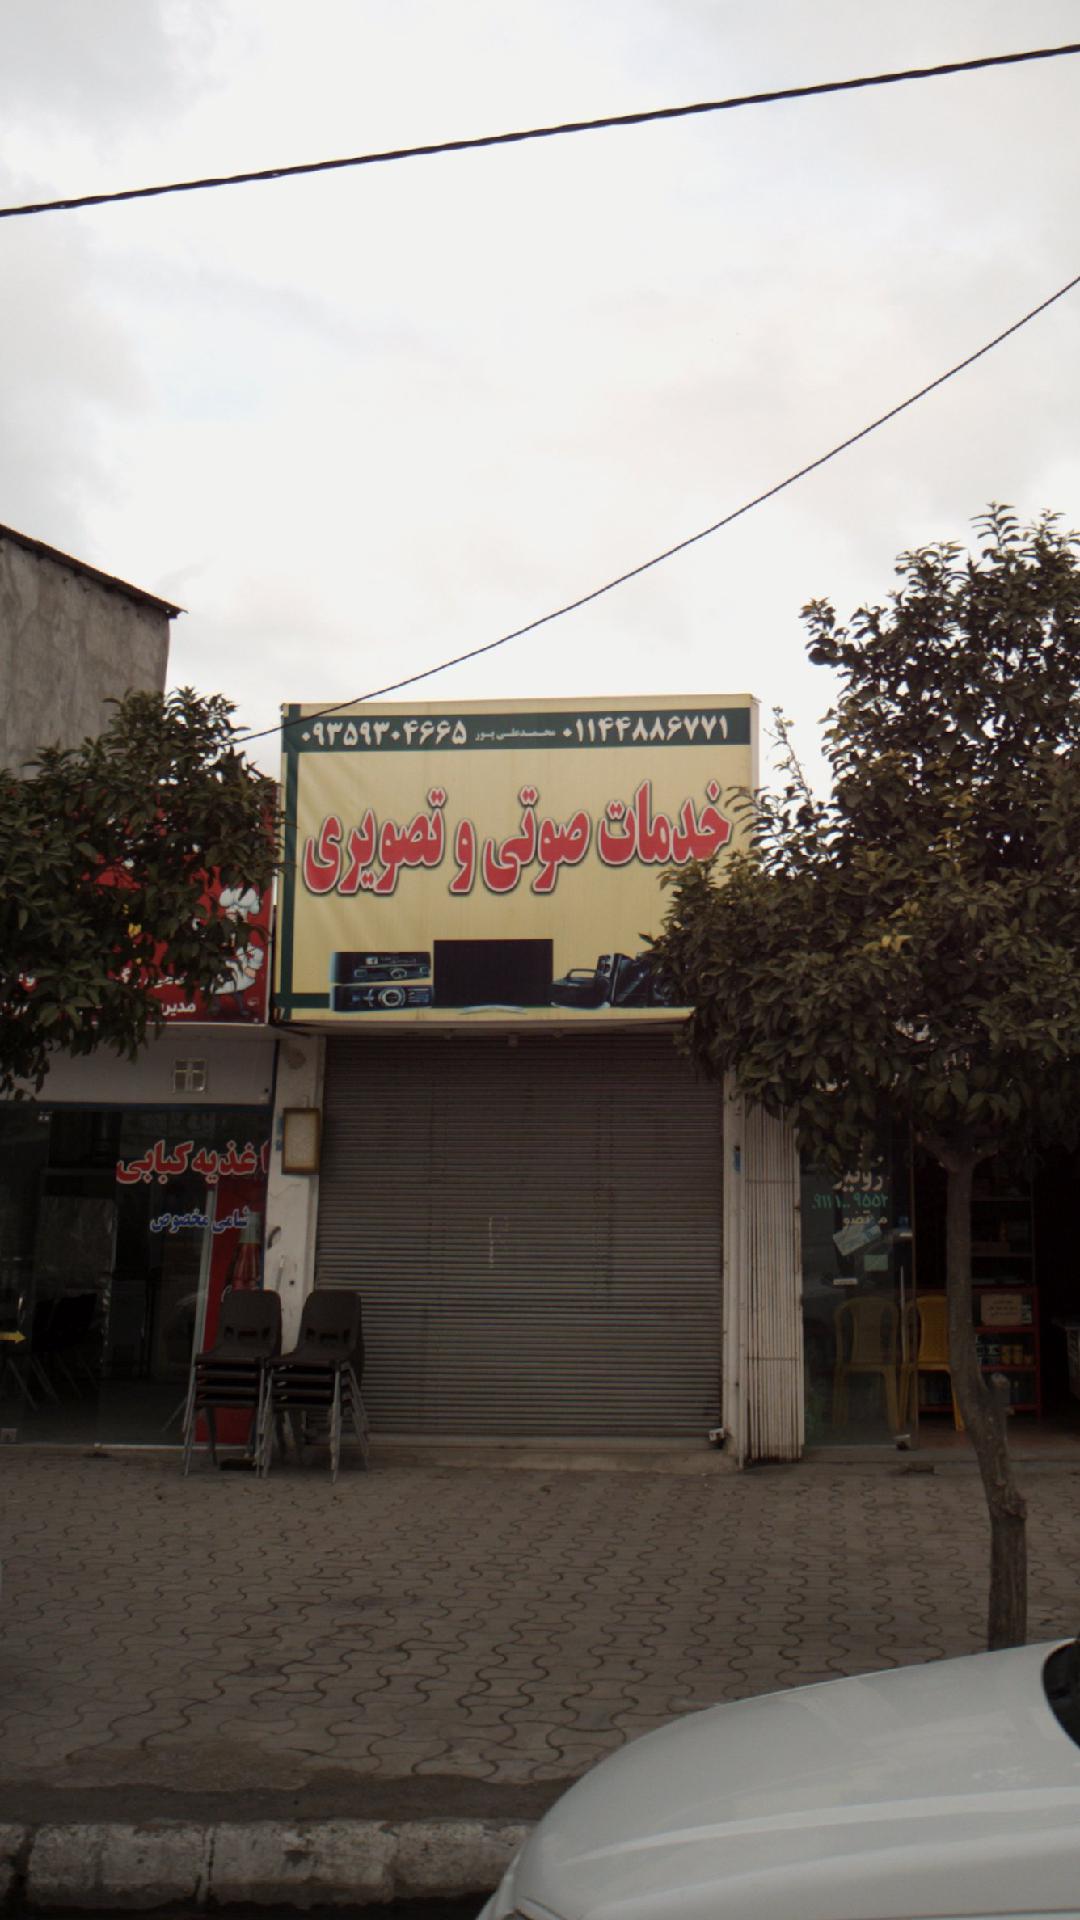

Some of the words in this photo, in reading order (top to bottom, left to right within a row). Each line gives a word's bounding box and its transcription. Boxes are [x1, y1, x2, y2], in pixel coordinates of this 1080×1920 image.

[302, 720, 467, 746] ۰۹۳۵۹۳۰۴۶۶۵
[562, 715, 728, 743] ۰۱۱۴۴۸۸۶۷۷۱
[303, 787, 446, 896] تصویری
[483, 785, 591, 895] صوتی
[598, 780, 733, 866] خدمات
[449, 818, 476, 895] و
[115, 1138, 194, 1185] کبابی
[190, 1139, 269, 1185] اغذیه
[149, 1207, 209, 1234] مخصوص
[211, 1205, 252, 1235] شامی
